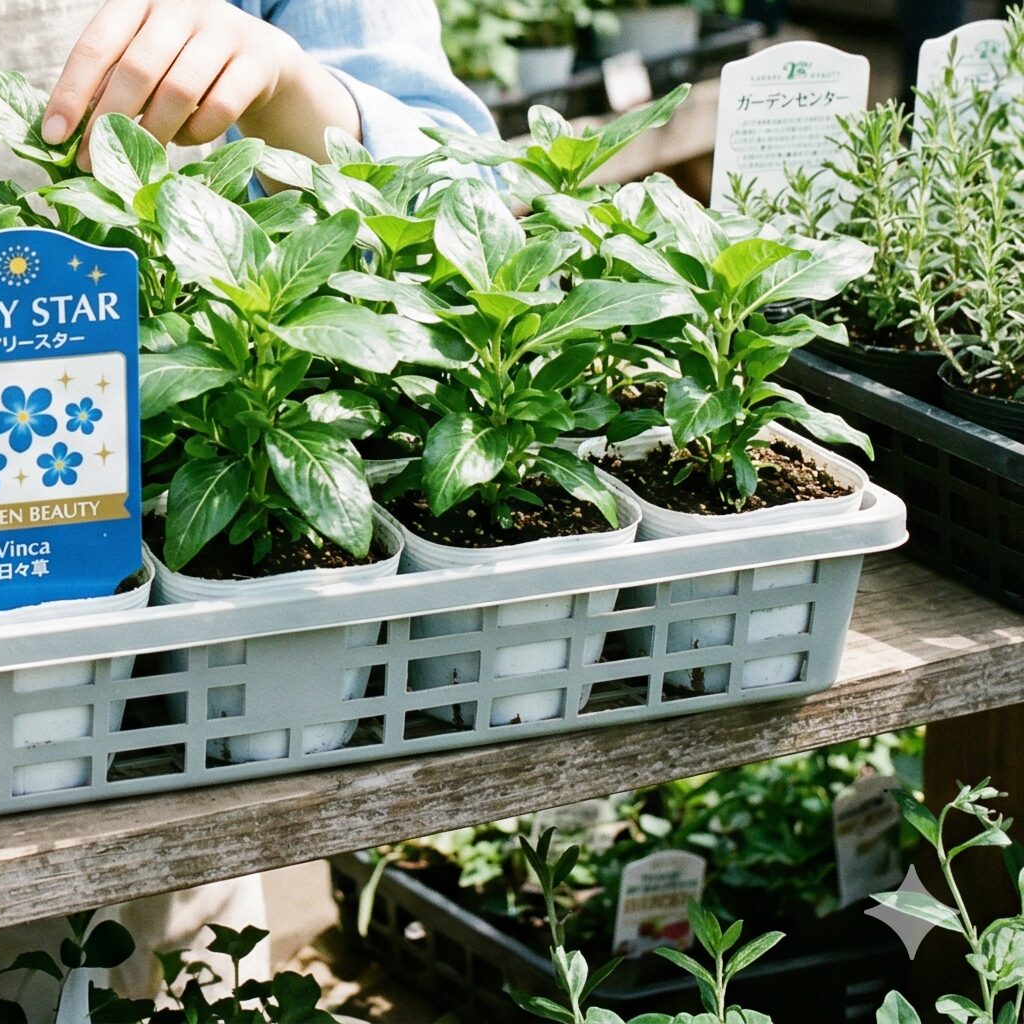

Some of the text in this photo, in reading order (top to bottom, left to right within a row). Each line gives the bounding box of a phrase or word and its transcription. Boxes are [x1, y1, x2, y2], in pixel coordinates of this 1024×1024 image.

[737, 90, 849, 111] ガーデンセンター
[32, 291, 121, 327] STAR
[29, 501, 101, 522] BEAUTY
